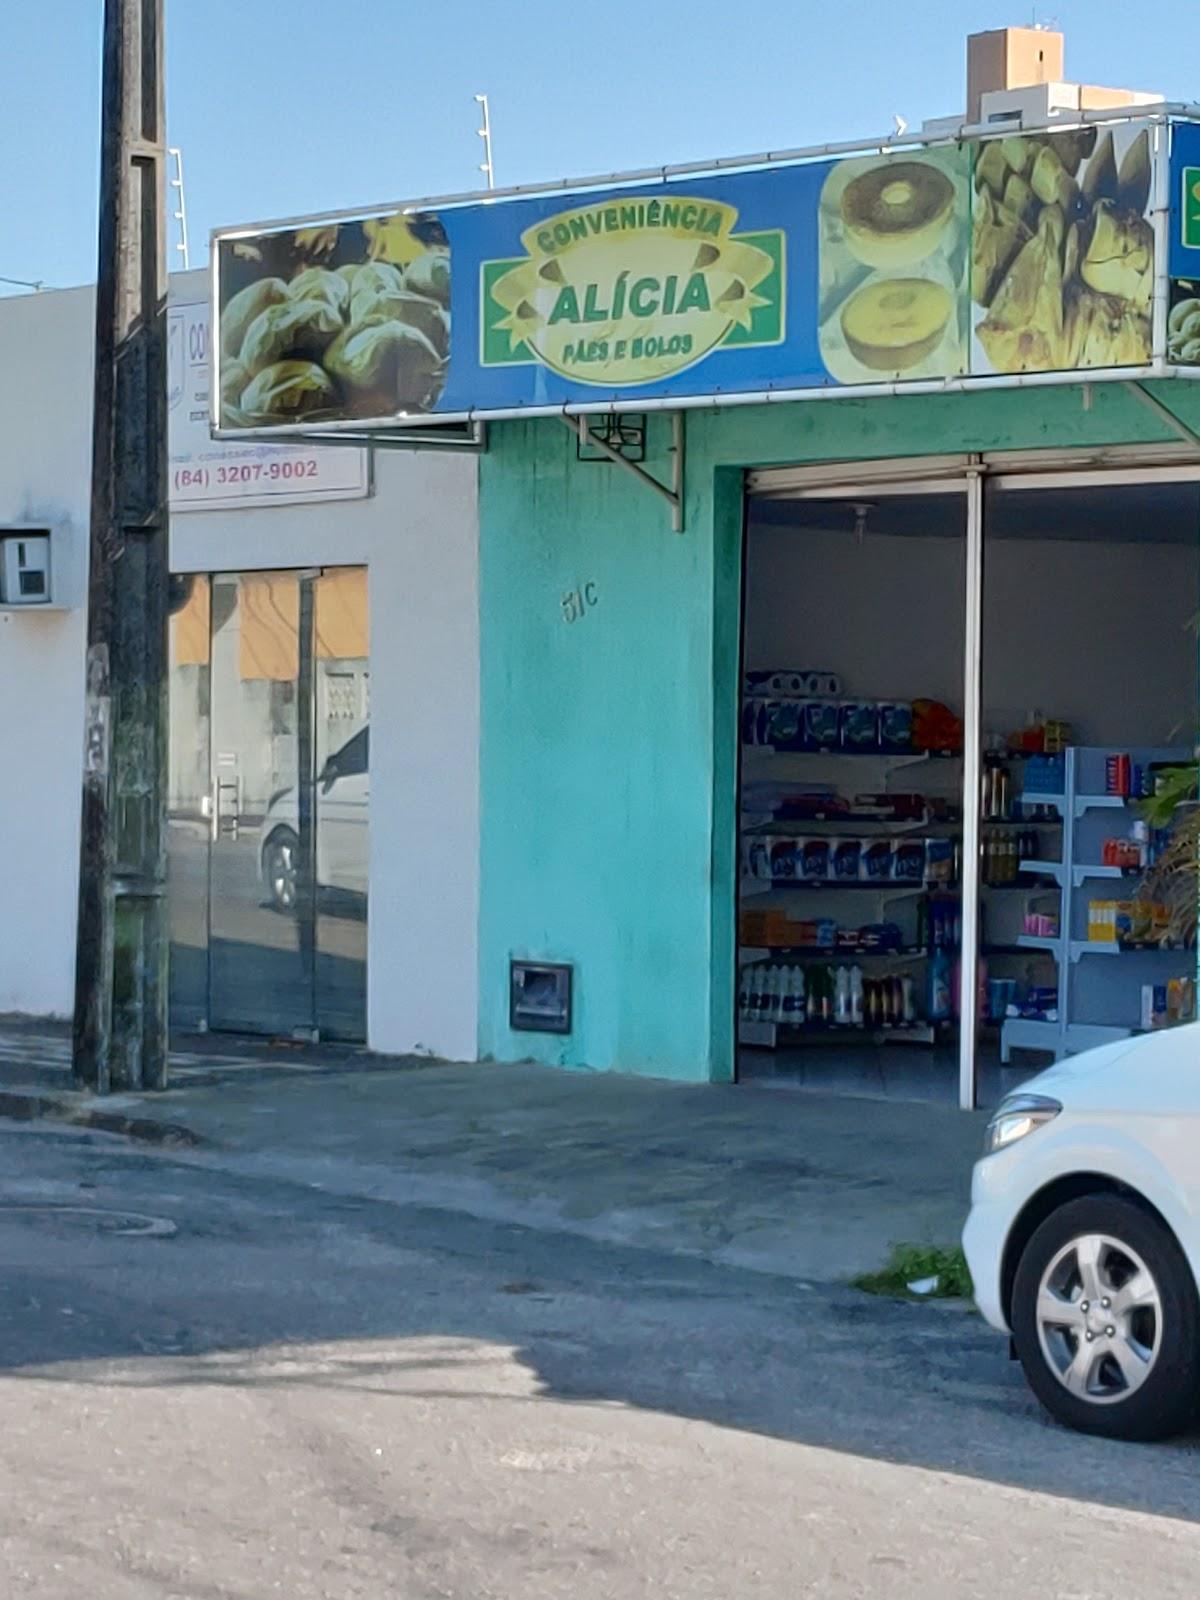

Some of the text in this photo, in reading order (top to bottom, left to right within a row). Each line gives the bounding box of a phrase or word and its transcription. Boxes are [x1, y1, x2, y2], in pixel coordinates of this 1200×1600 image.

[537, 199, 724, 254] CONVENIÊNCIA
[547, 270, 711, 326] ALÍCIA
[615, 340, 626, 360] E
[631, 334, 692, 359] BOLOS
[175, 460, 318, 490] (84) 3207-9002
